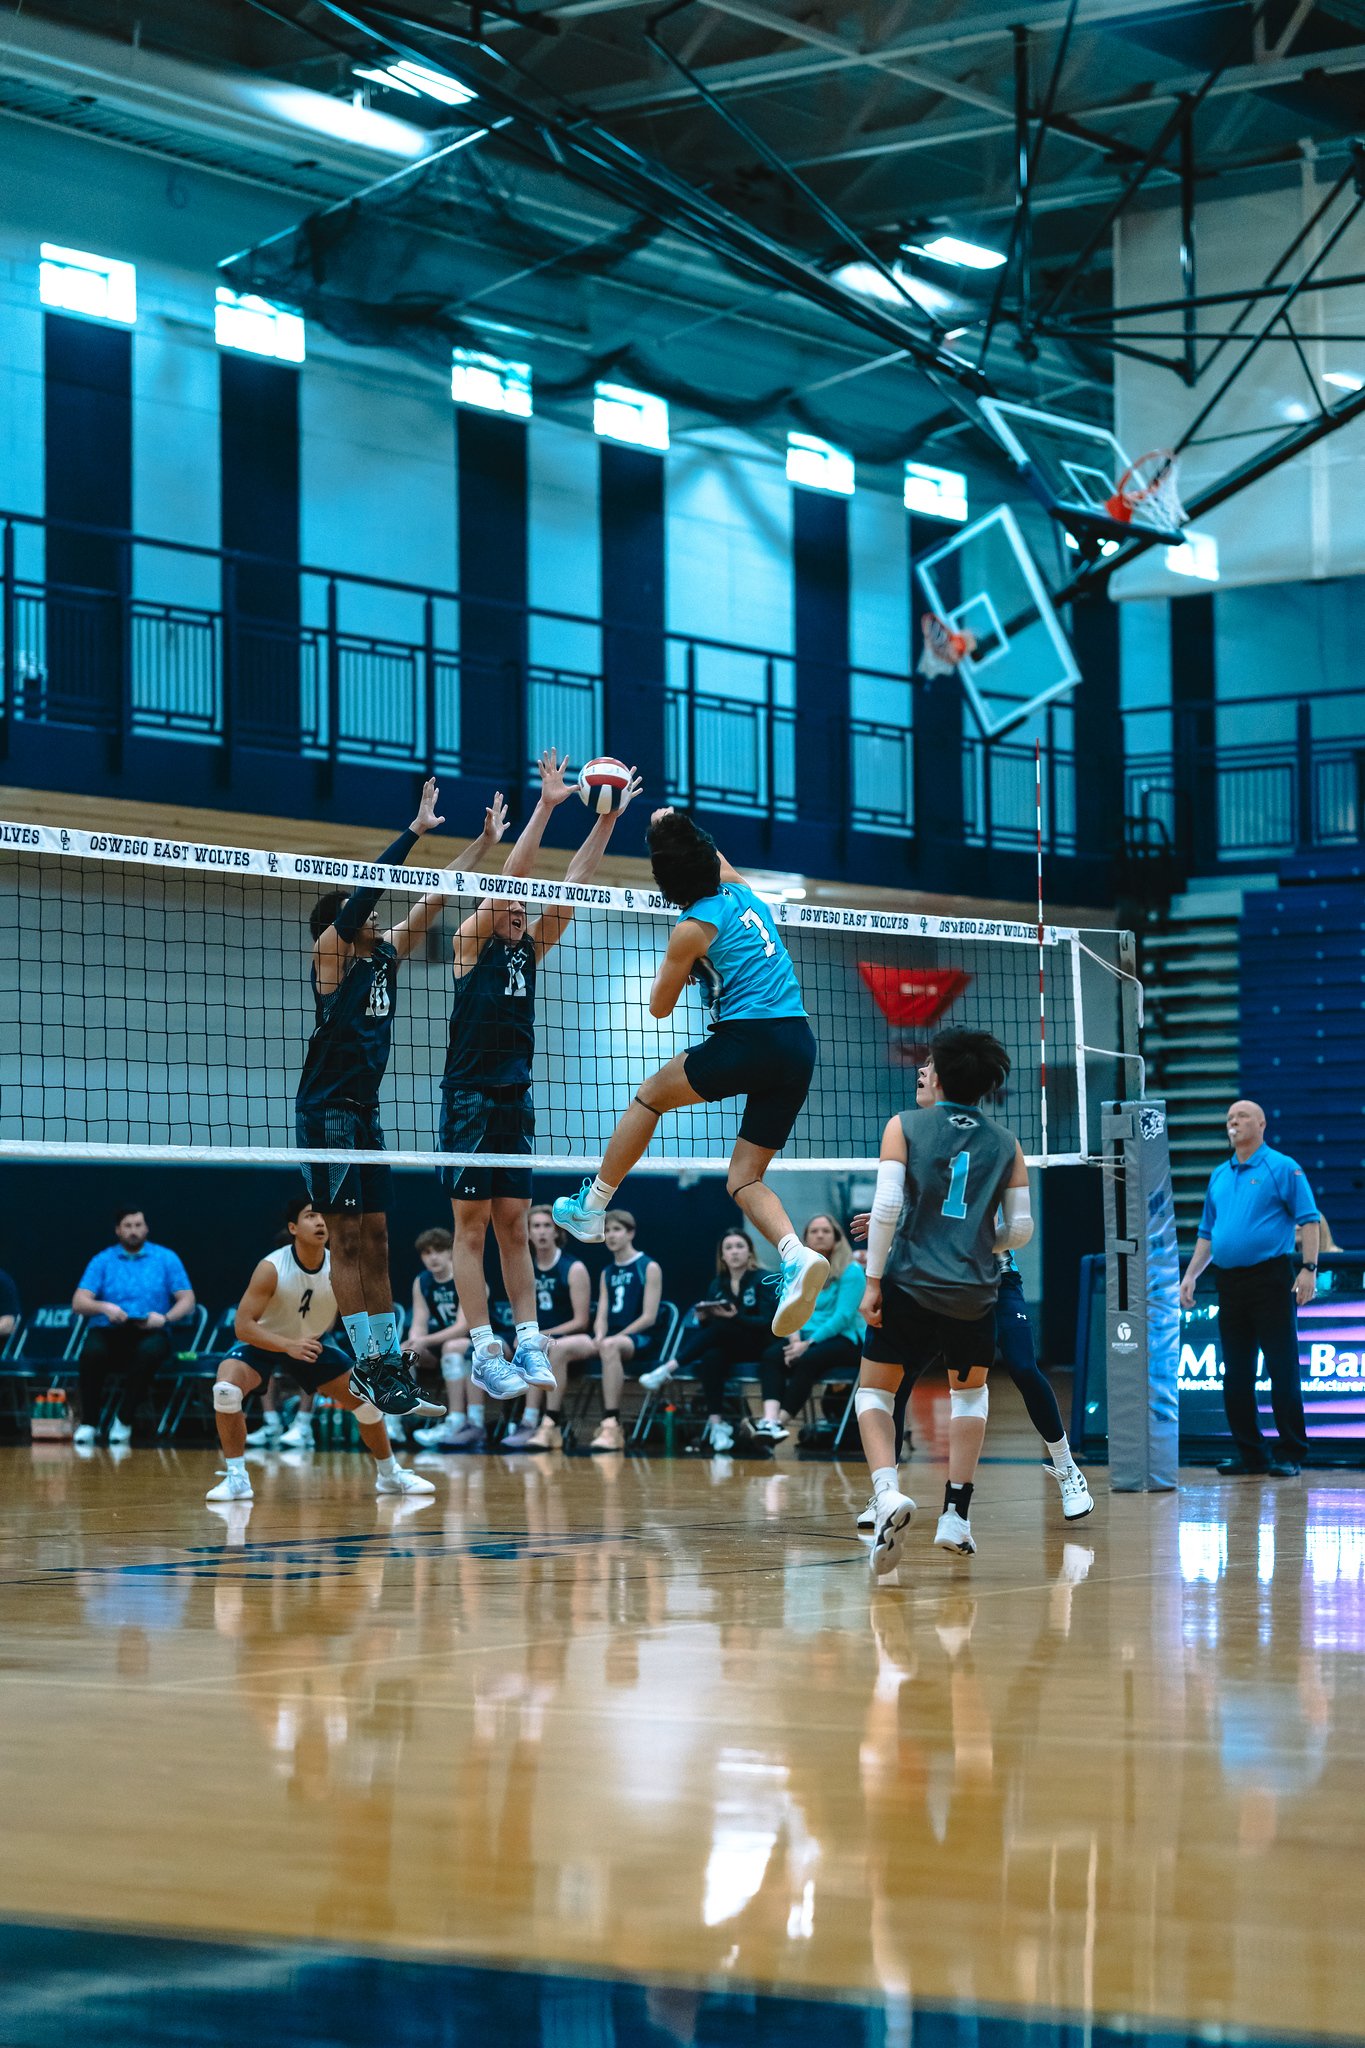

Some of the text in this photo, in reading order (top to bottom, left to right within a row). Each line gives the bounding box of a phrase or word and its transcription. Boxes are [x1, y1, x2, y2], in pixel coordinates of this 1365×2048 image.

[0, 827, 40, 845] LVES
[89, 835, 250, 867] OSWEGO EAST WOLVES
[294, 858, 440, 887] OSWEGO EAST WOLVES
[479, 877, 611, 904] OSWEGO EAST WOLVES
[648, 894, 684, 910] OSW
[800, 908, 909, 930] OSWEGO EAST WOLVES
[939, 920, 1038, 939] OSWEGO EAST WOLVES
[941, 1151, 970, 1220] 1
[298, 1288, 313, 1319] 4
[611, 1285, 626, 1314] 3
[1310, 1343, 1365, 1378] Ba
